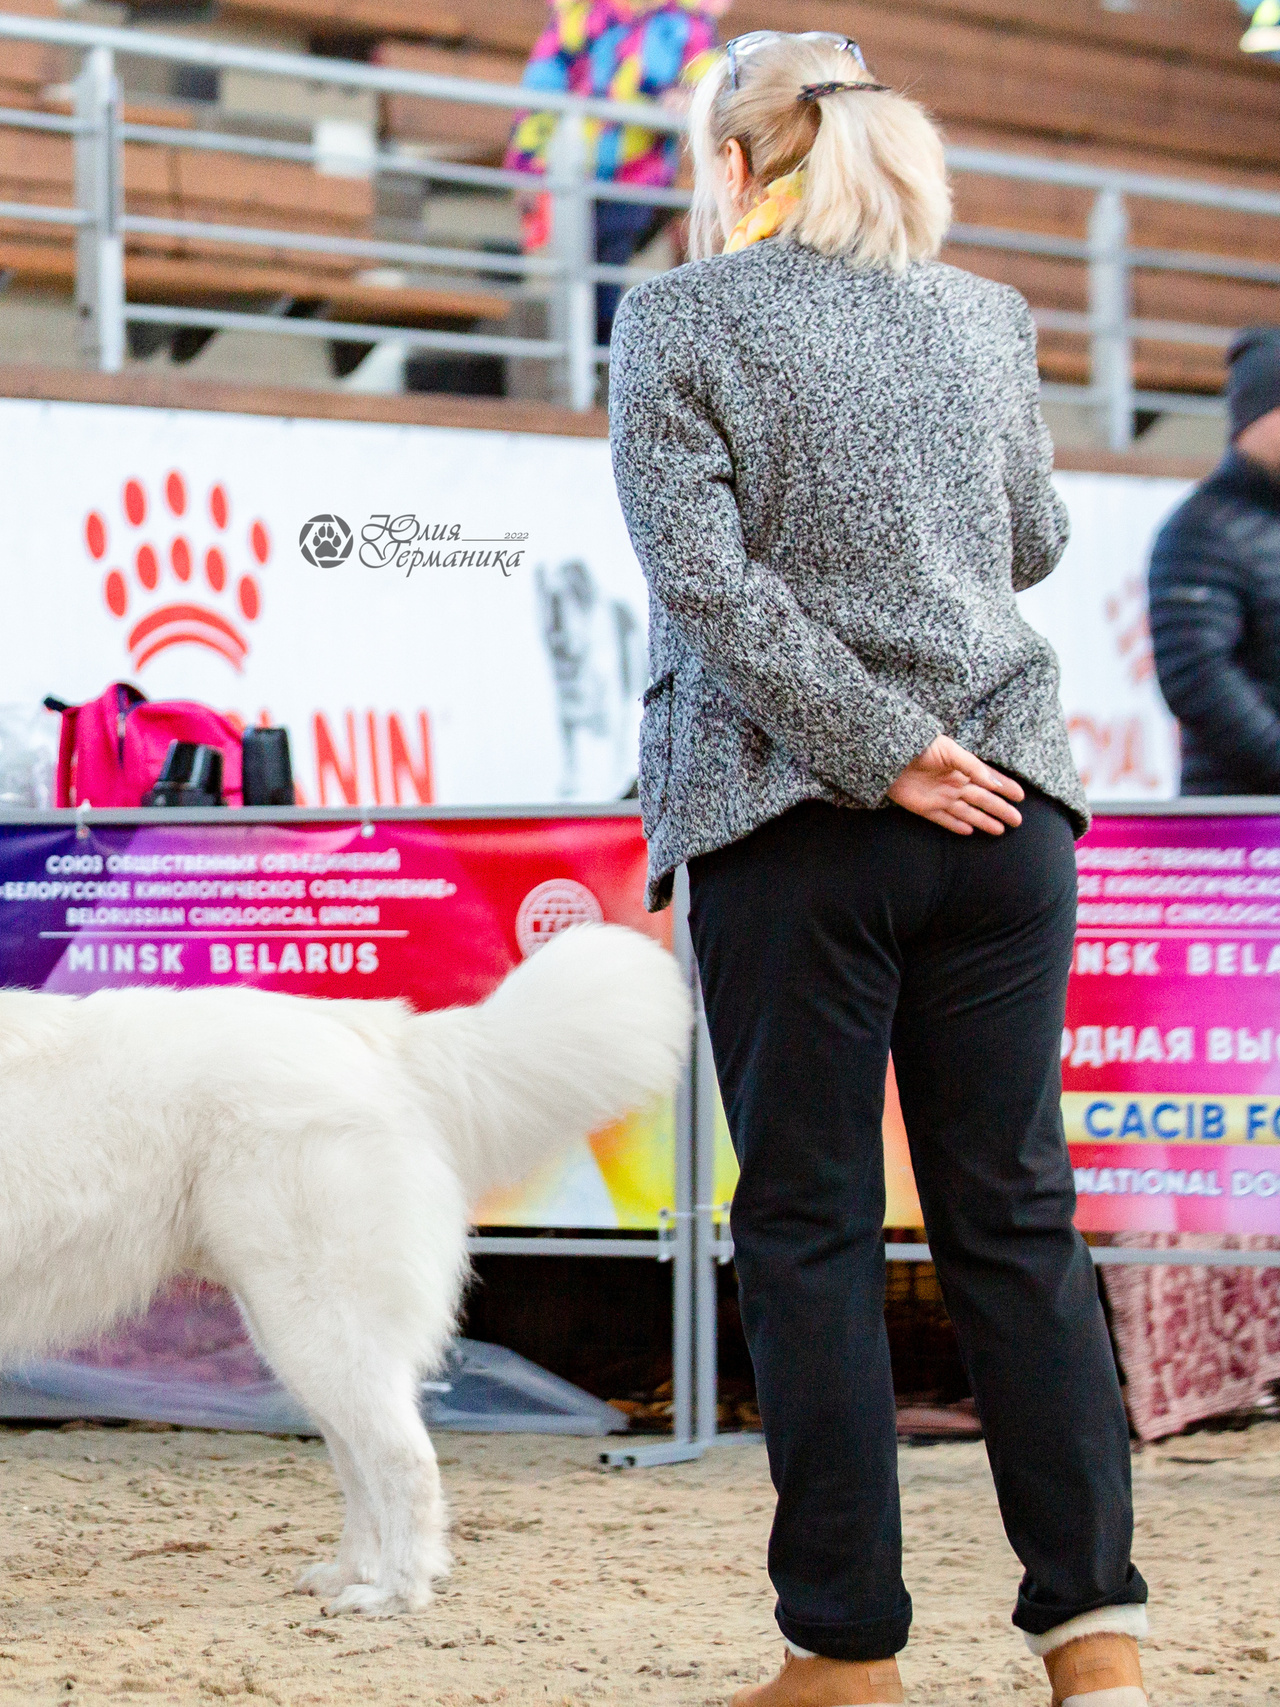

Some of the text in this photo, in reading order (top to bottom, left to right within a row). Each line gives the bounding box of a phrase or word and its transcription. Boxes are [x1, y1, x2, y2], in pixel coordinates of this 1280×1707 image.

[68, 942, 380, 975] MINSK BELARUS
[1204, 1026, 1280, 1064] ВЫ
[1084, 1101, 1227, 1141] CACIB
